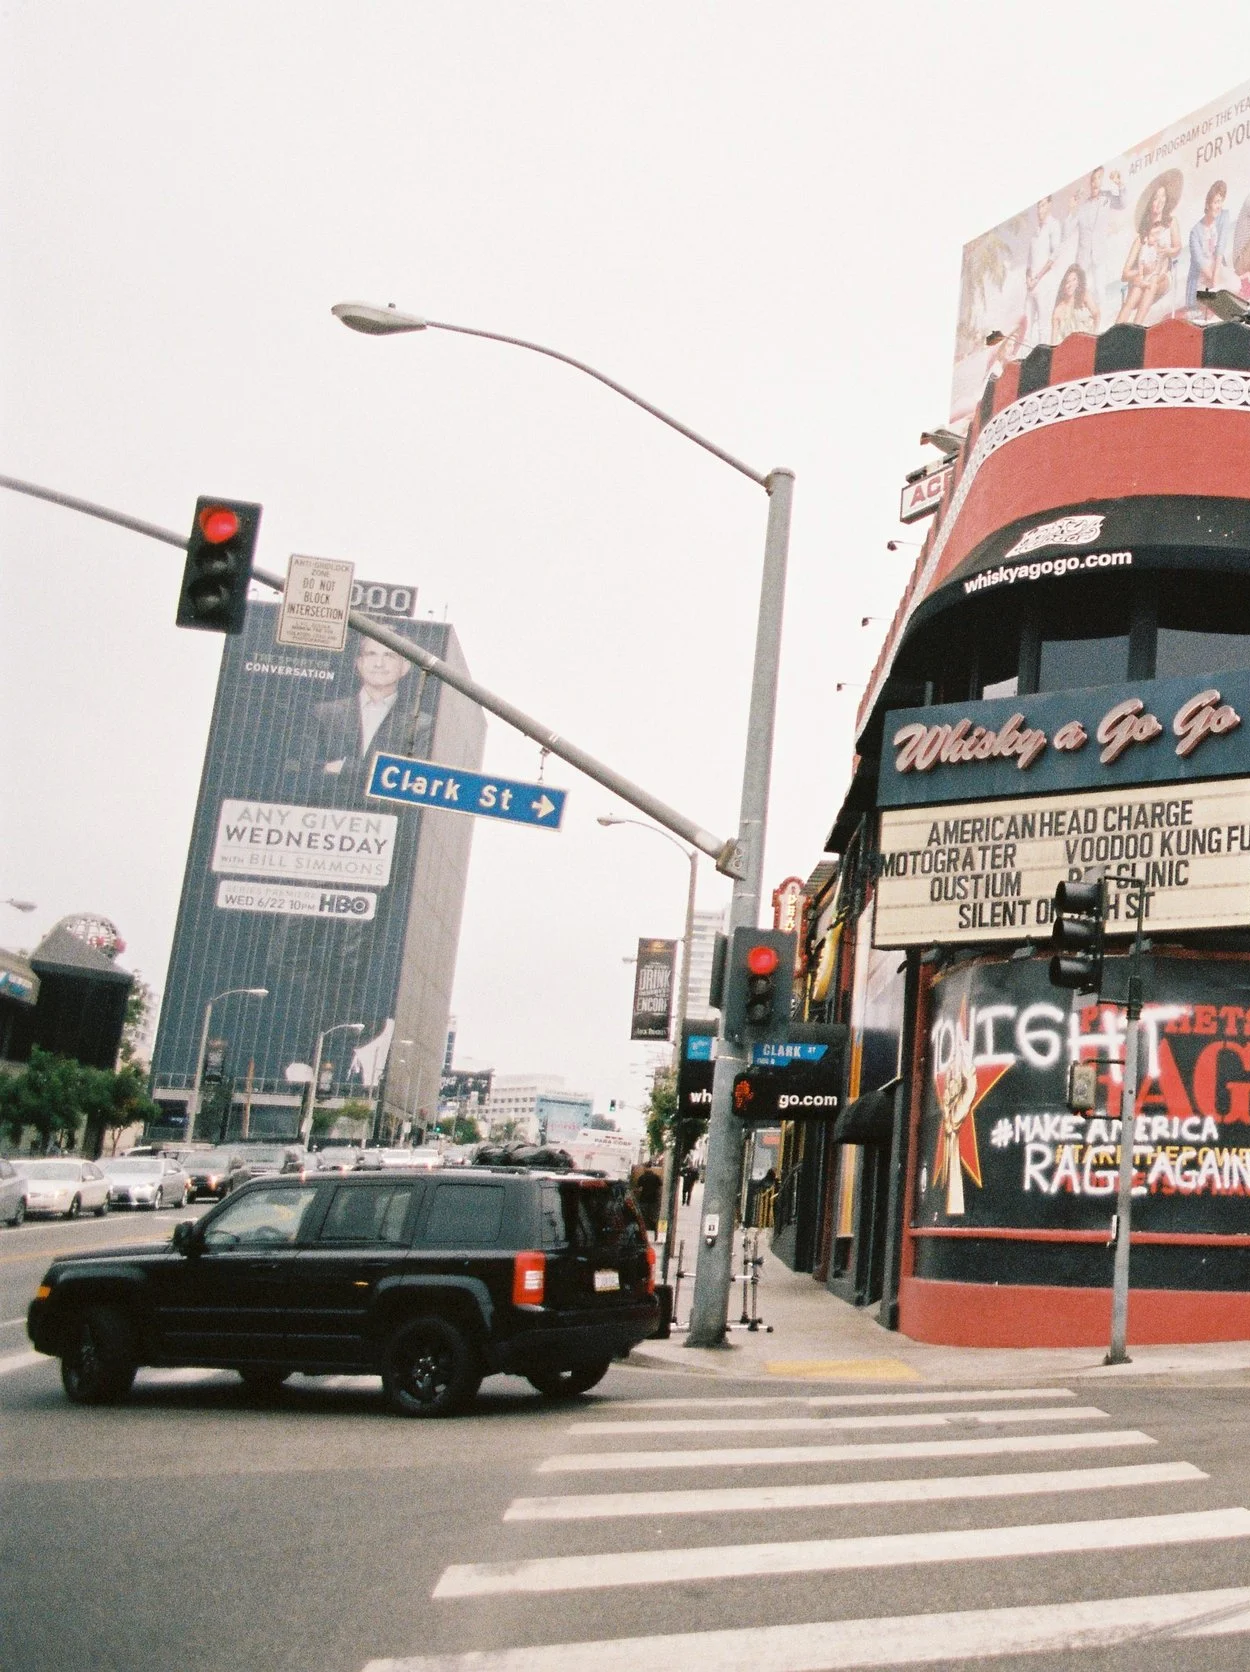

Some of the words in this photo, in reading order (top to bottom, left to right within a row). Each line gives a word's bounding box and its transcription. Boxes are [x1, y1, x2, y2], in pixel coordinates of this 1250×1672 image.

[1129, 159, 1143, 176] AFI
[1144, 154, 1154, 167] TV
[1155, 126, 1200, 163] PROGRAM
[1201, 120, 1214, 135] OF
[1215, 110, 1233, 128] THE
[1195, 136, 1223, 168] FOR
[303, 577, 315, 589] DO
[320, 580, 336, 591] NOT
[311, 569, 329, 578] ZONE
[963, 552, 1132, 594] whiskyagogo.com
[287, 603, 343, 620] INTERSECTION
[304, 591, 330, 604] BLOCK
[245, 661, 335, 680] CONVERSATION
[893, 711, 1047, 773] Whisky
[1053, 720, 1088, 751] a
[1097, 698, 1163, 765] Go
[1172, 688, 1241, 758] Go
[381, 766, 459, 802] Clark
[480, 785, 514, 811] St
[237, 806, 291, 826] ANY
[301, 812, 382, 834] GIVEN
[928, 812, 1035, 847] AMERICAN
[1039, 808, 1098, 839] HEAD
[1103, 799, 1193, 832] CHARGE
[226, 824, 388, 855] WEDNESDAY
[880, 843, 1017, 877] MOTOGRATER
[1064, 832, 1154, 865] VOODOO
[1160, 826, 1222, 858] KUNG
[221, 854, 244, 864] WITH
[250, 854, 287, 868] BILL
[295, 857, 384, 877] SIMMONS
[930, 871, 1022, 902] OUSTIUM
[1116, 860, 1189, 890] CLINIC
[225, 894, 253, 906] WED
[257, 898, 284, 909] 6/22
[289, 899, 316, 911] 10PM
[318, 893, 370, 915] HBO
[959, 899, 1031, 929] SILENT
[1126, 892, 1155, 919] ST
[763, 1044, 801, 1057] CLARK
[991, 1114, 1085, 1147] #MAKE
